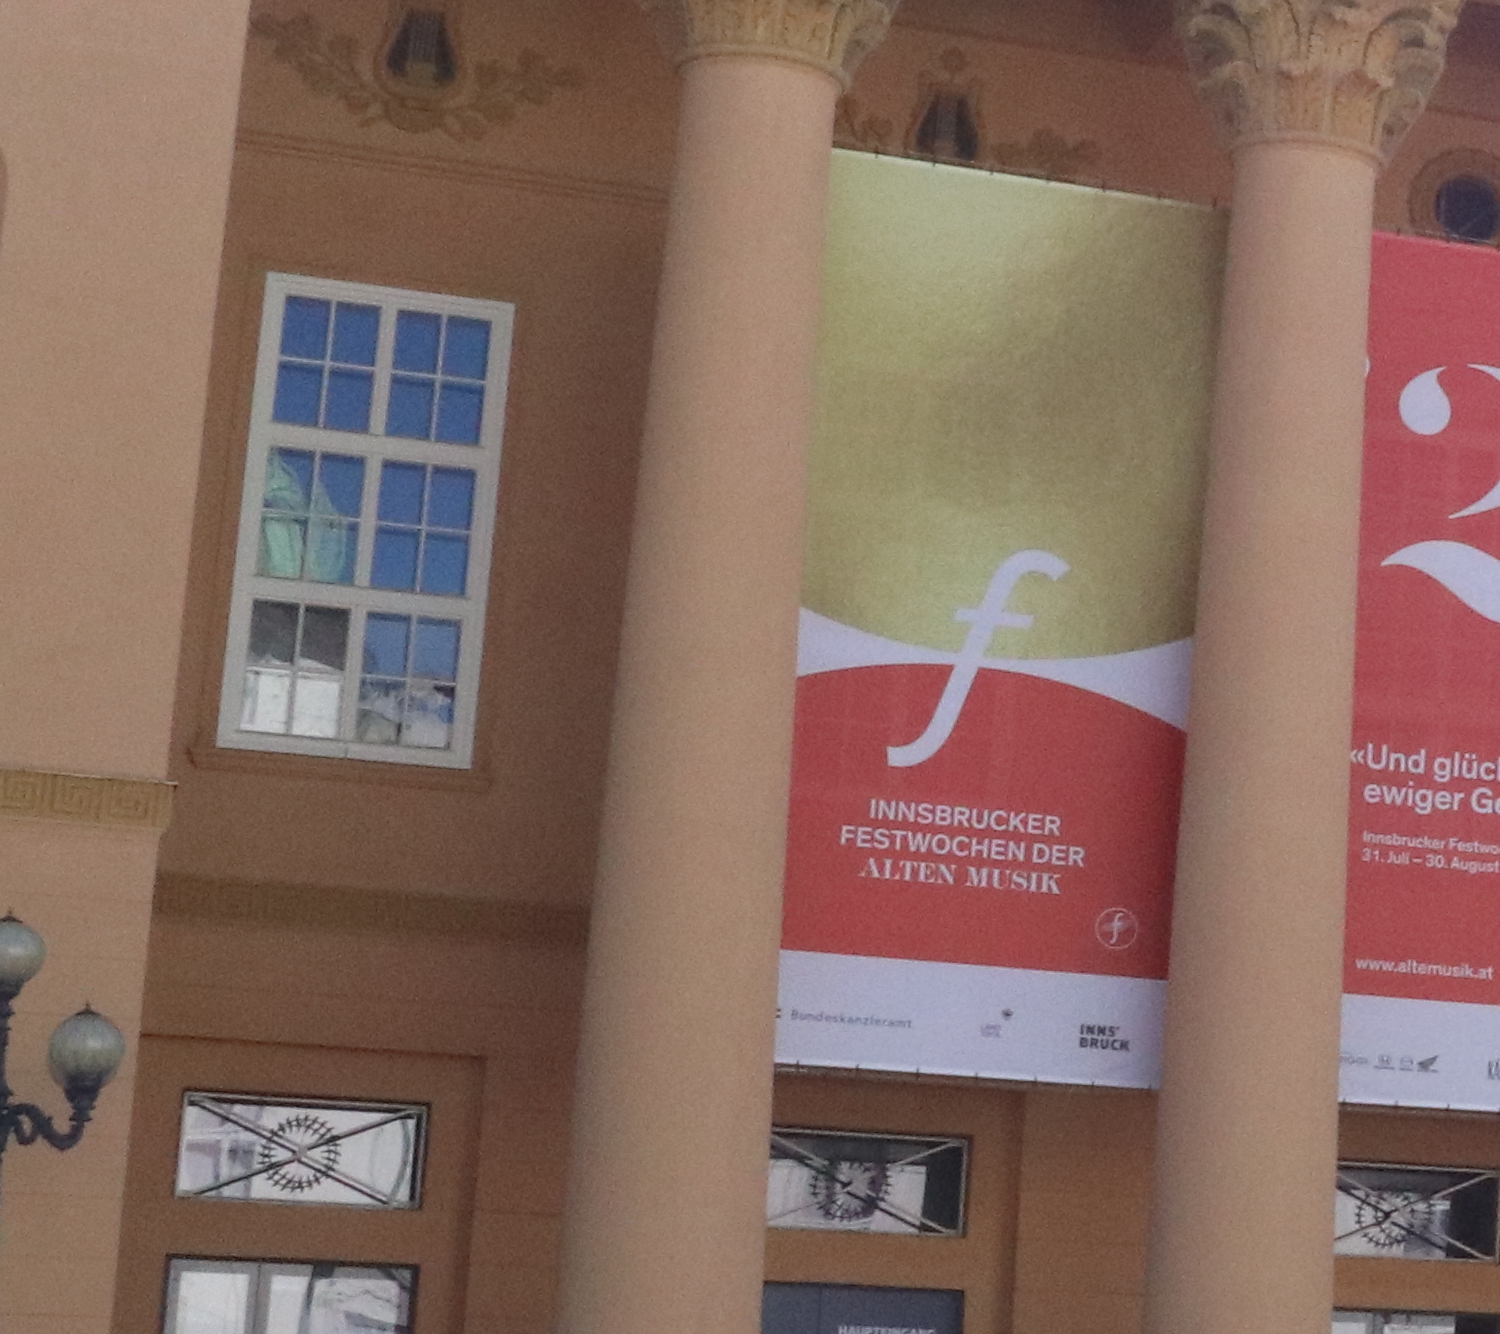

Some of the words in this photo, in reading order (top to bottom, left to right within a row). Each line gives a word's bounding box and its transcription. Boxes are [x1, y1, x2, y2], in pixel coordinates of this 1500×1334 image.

[1363, 781, 1465, 815] ewiger
[868, 798, 1062, 837] INNSBRUCKER
[840, 824, 1027, 862] FESTWOCHEN
[1032, 843, 1086, 868] DER
[1362, 829, 1446, 850] Innsbrucker
[1362, 847, 1384, 863] 31.
[1387, 851, 1410, 865] Juli
[1425, 854, 1448, 869] 30.
[1450, 857, 1500, 875] August
[858, 857, 956, 886] ALTEN
[966, 867, 1062, 895] MUSIK
[1355, 956, 1494, 981] www.altemusik.at
[791, 1009, 912, 1029] Bundeskanzleramt
[1079, 1037, 1130, 1051] BRUCK
